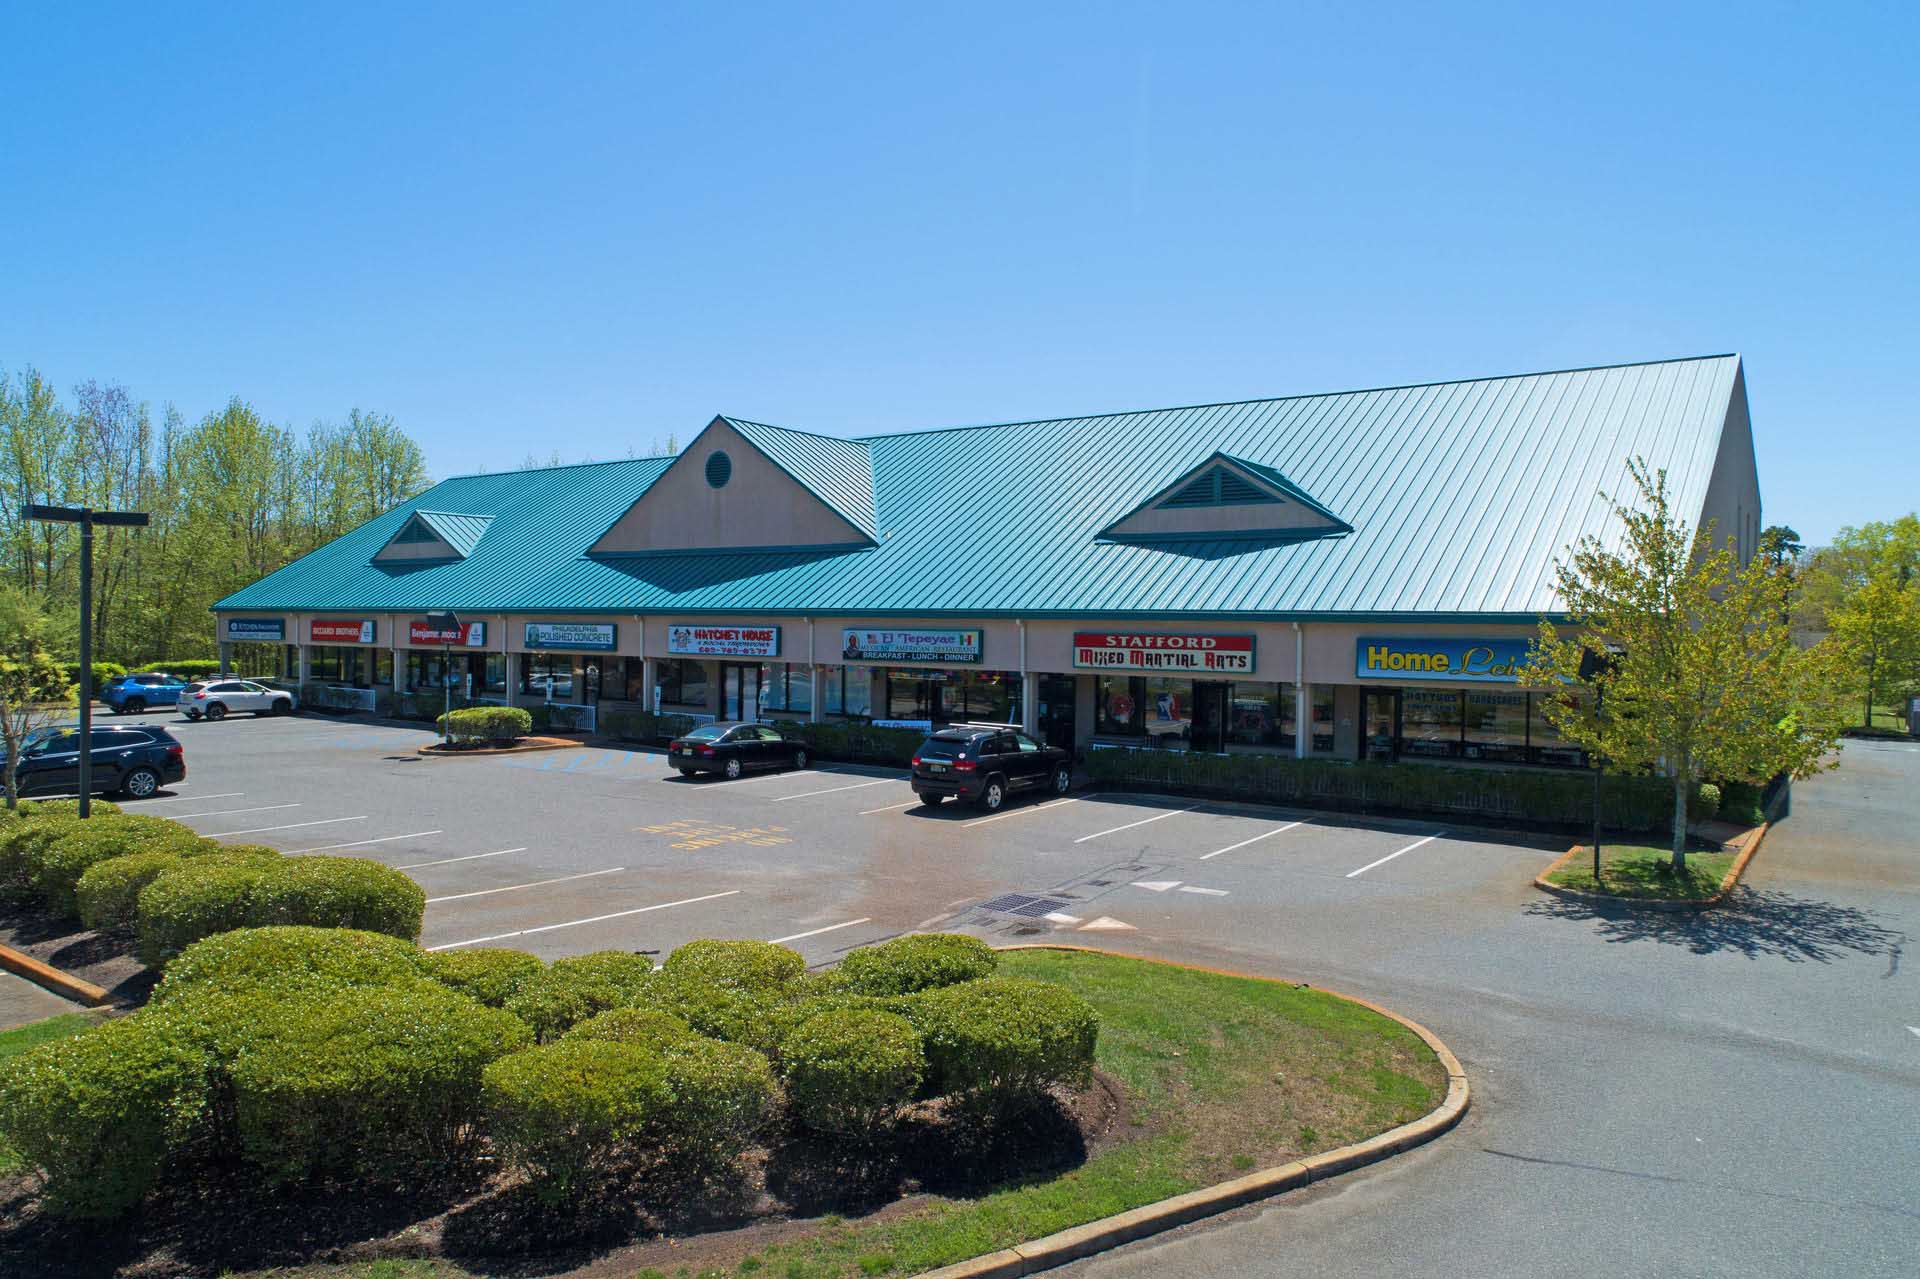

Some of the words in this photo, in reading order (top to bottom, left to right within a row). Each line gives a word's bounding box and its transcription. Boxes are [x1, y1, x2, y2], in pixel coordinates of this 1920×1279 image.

[540, 631, 573, 641] POLISHED
[574, 632, 611, 642] CONCRETE
[694, 629, 740, 641] HATCHET
[742, 630, 774, 641] HOUSE
[881, 633, 894, 644] El
[897, 633, 955, 645] Tepeyac
[1106, 636, 1217, 649] STAFFORD
[863, 651, 908, 660] BREAKFAST
[944, 653, 974, 662] DINNER
[1079, 649, 1125, 666] MIXED
[1129, 650, 1199, 668] MARTIAL
[1204, 652, 1247, 669] ARTS
[1367, 646, 1449, 672] Home
